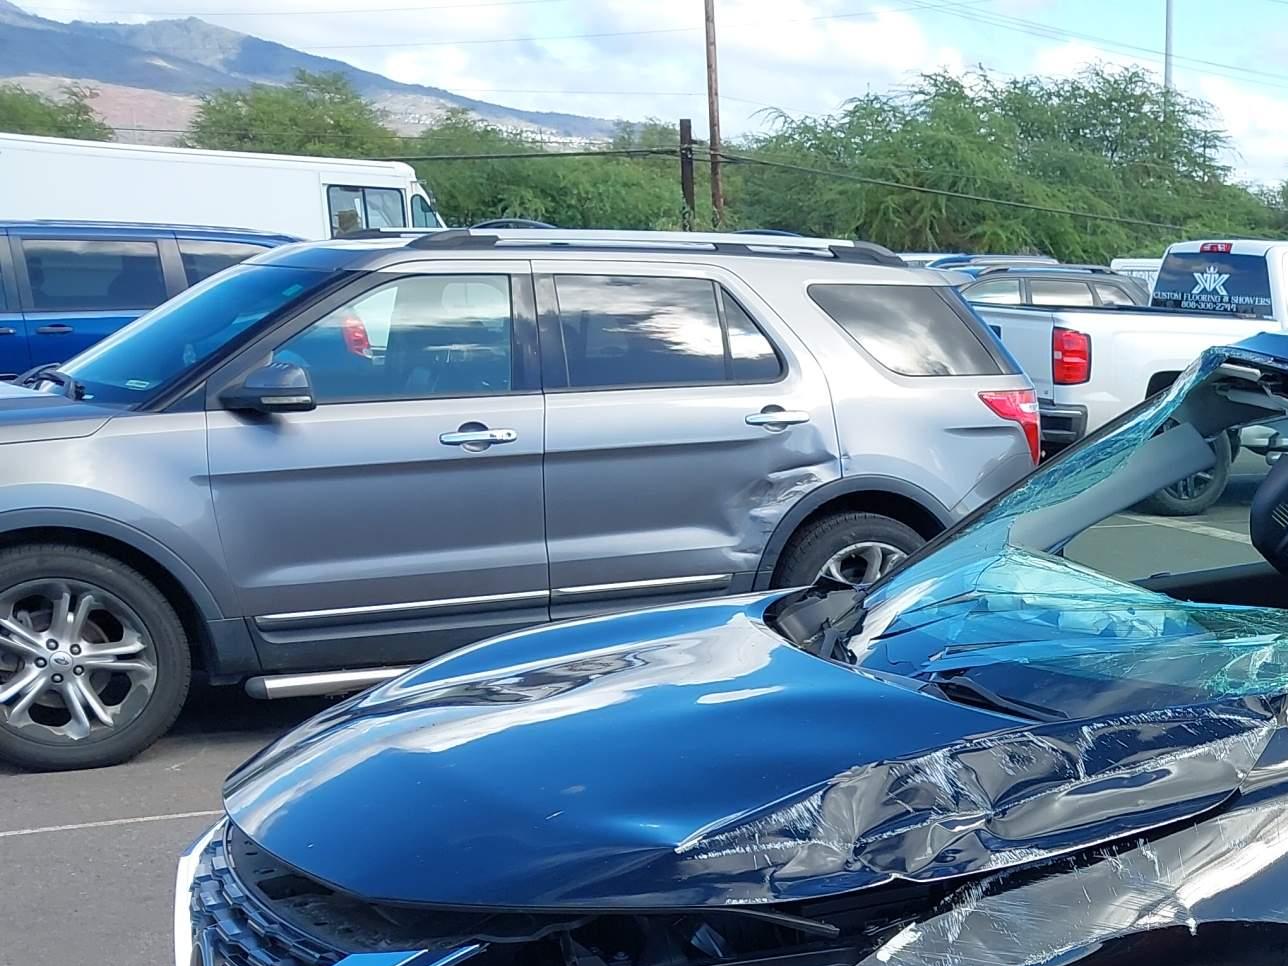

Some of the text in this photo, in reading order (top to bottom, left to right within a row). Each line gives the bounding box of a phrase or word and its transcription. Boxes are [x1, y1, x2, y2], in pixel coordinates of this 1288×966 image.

[1154, 291, 1182, 300] CUSTOM
[1184, 293, 1221, 303] FLOORING
[1230, 296, 1271, 306] SHOWERS
